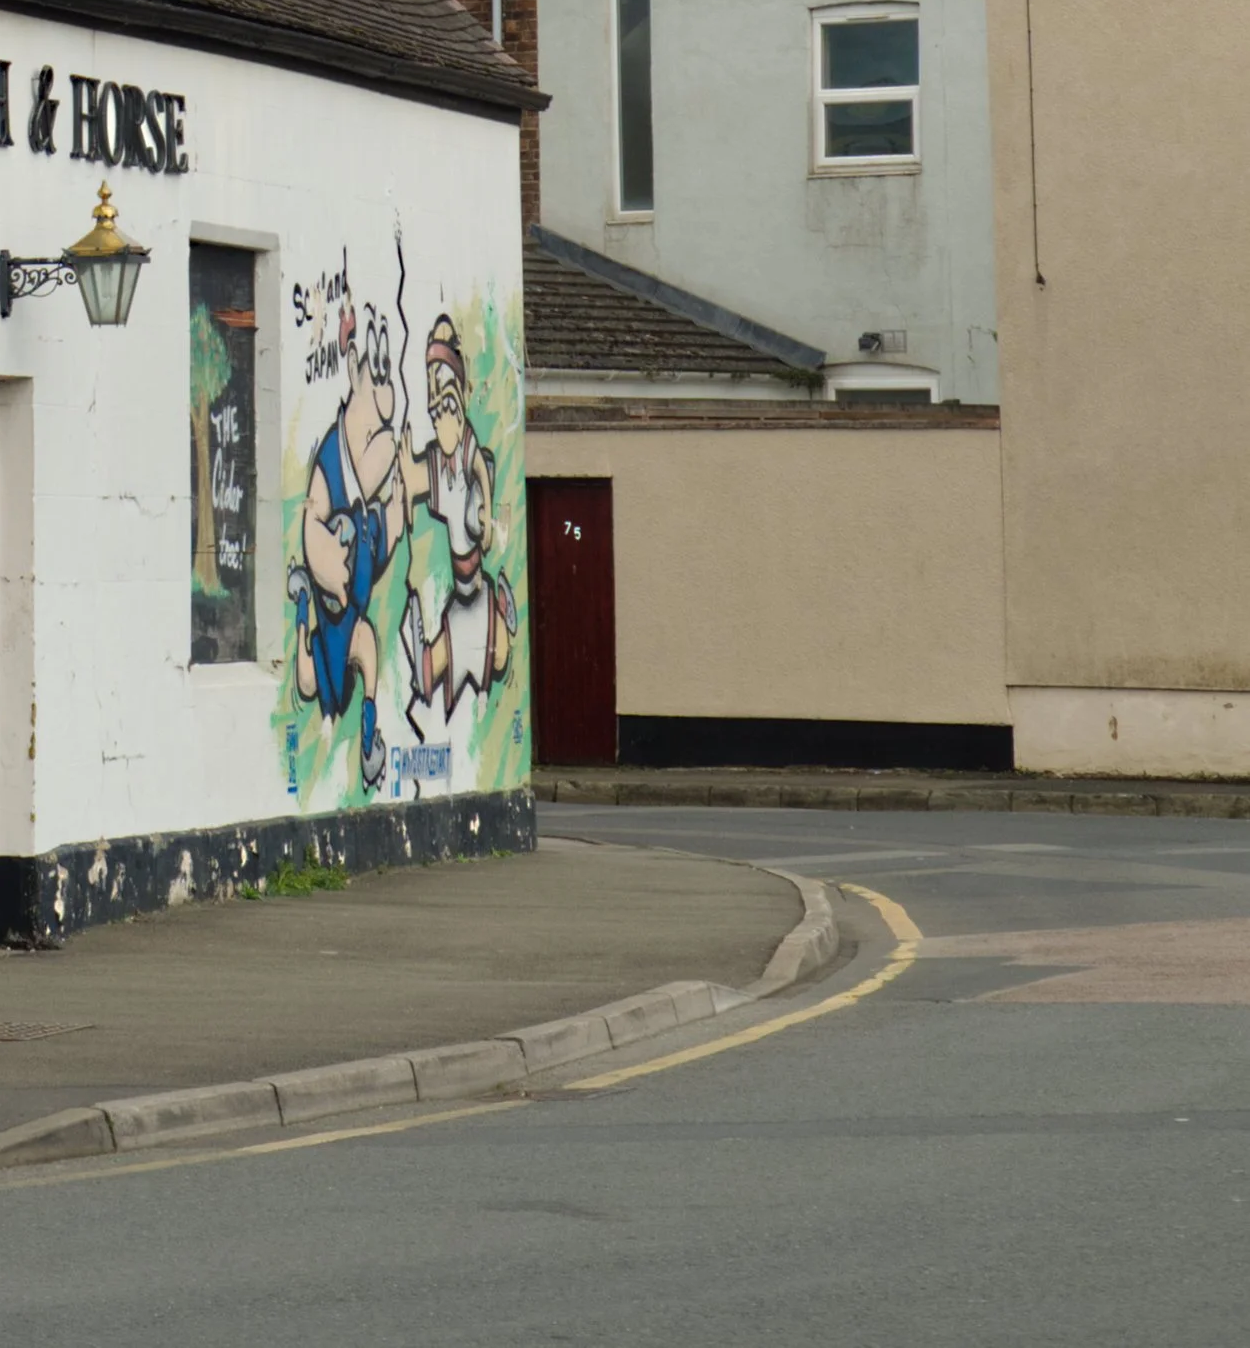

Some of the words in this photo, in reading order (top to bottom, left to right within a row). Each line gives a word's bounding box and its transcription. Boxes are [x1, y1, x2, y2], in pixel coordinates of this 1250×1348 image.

[28, 65, 60, 154] &
[69, 74, 188, 174] HORSE
[306, 340, 339, 385] JAPAN
[210, 405, 240, 447] THE
[212, 447, 243, 513] Cider
[219, 522, 246, 571] tree!
[564, 520, 582, 541] 75
